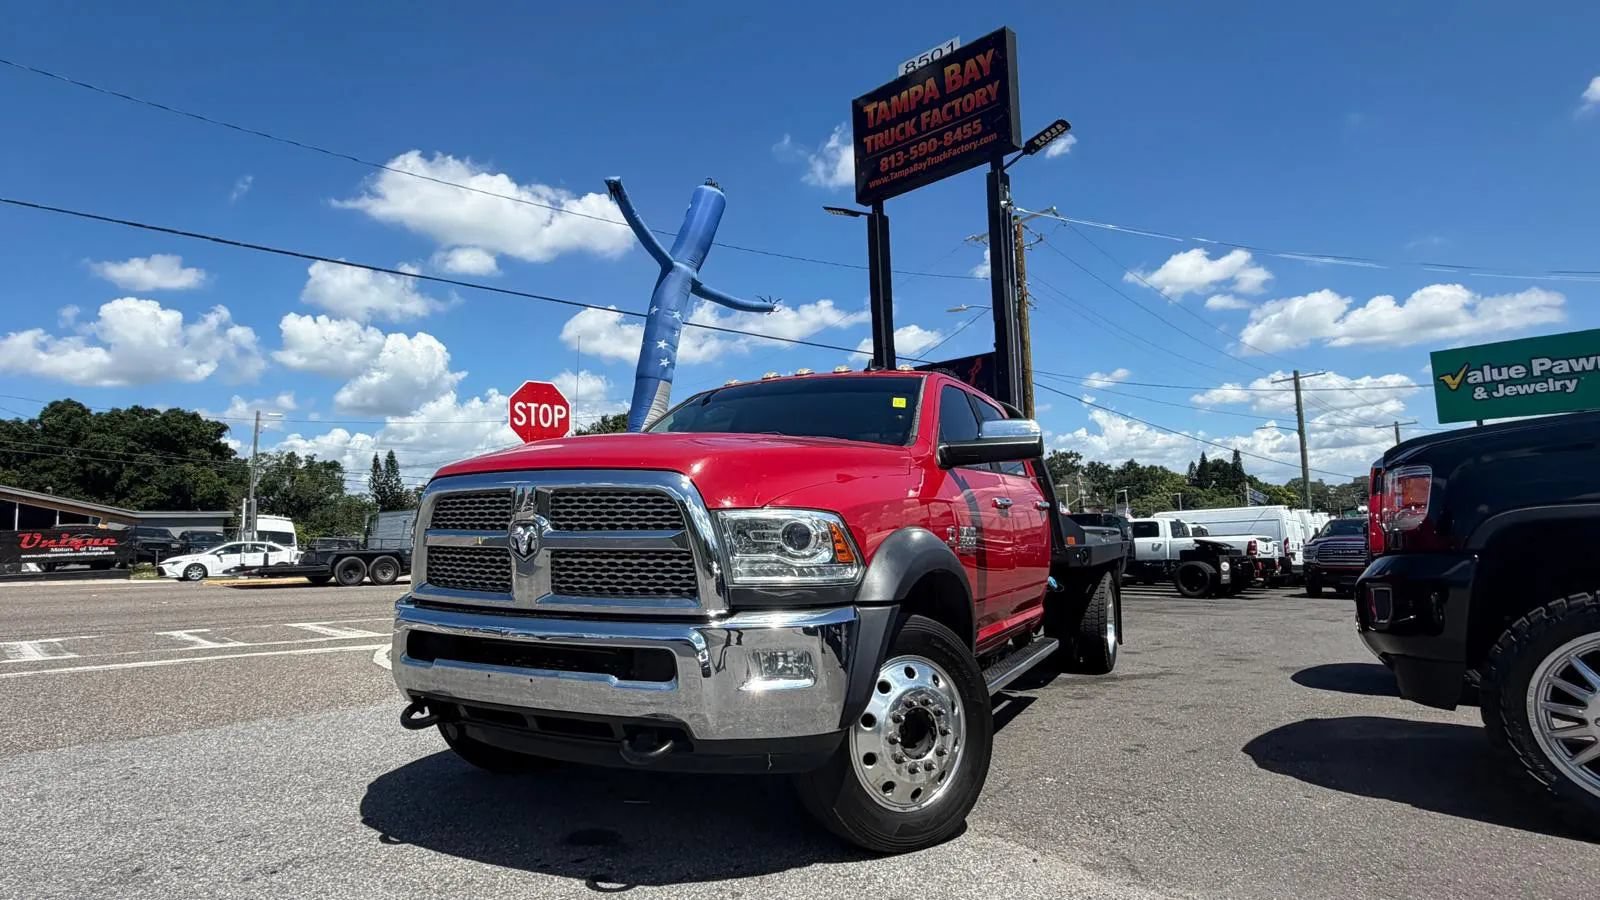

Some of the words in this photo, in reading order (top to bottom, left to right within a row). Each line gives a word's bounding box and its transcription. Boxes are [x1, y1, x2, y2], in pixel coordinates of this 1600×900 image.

[905, 41, 954, 74] 8501
[863, 77, 940, 128] TAMPA
[944, 48, 995, 94] BAY
[863, 116, 918, 154] TRUCK
[921, 80, 1000, 131] FACTORY
[868, 133, 998, 189] www.TampaBayTruckFactory.com
[879, 118, 983, 173] 813-590-8455
[1473, 387, 1489, 400] &
[1493, 378, 1578, 398] Jewelry
[513, 401, 567, 428] STOP
[18, 532, 118, 551] Unique
